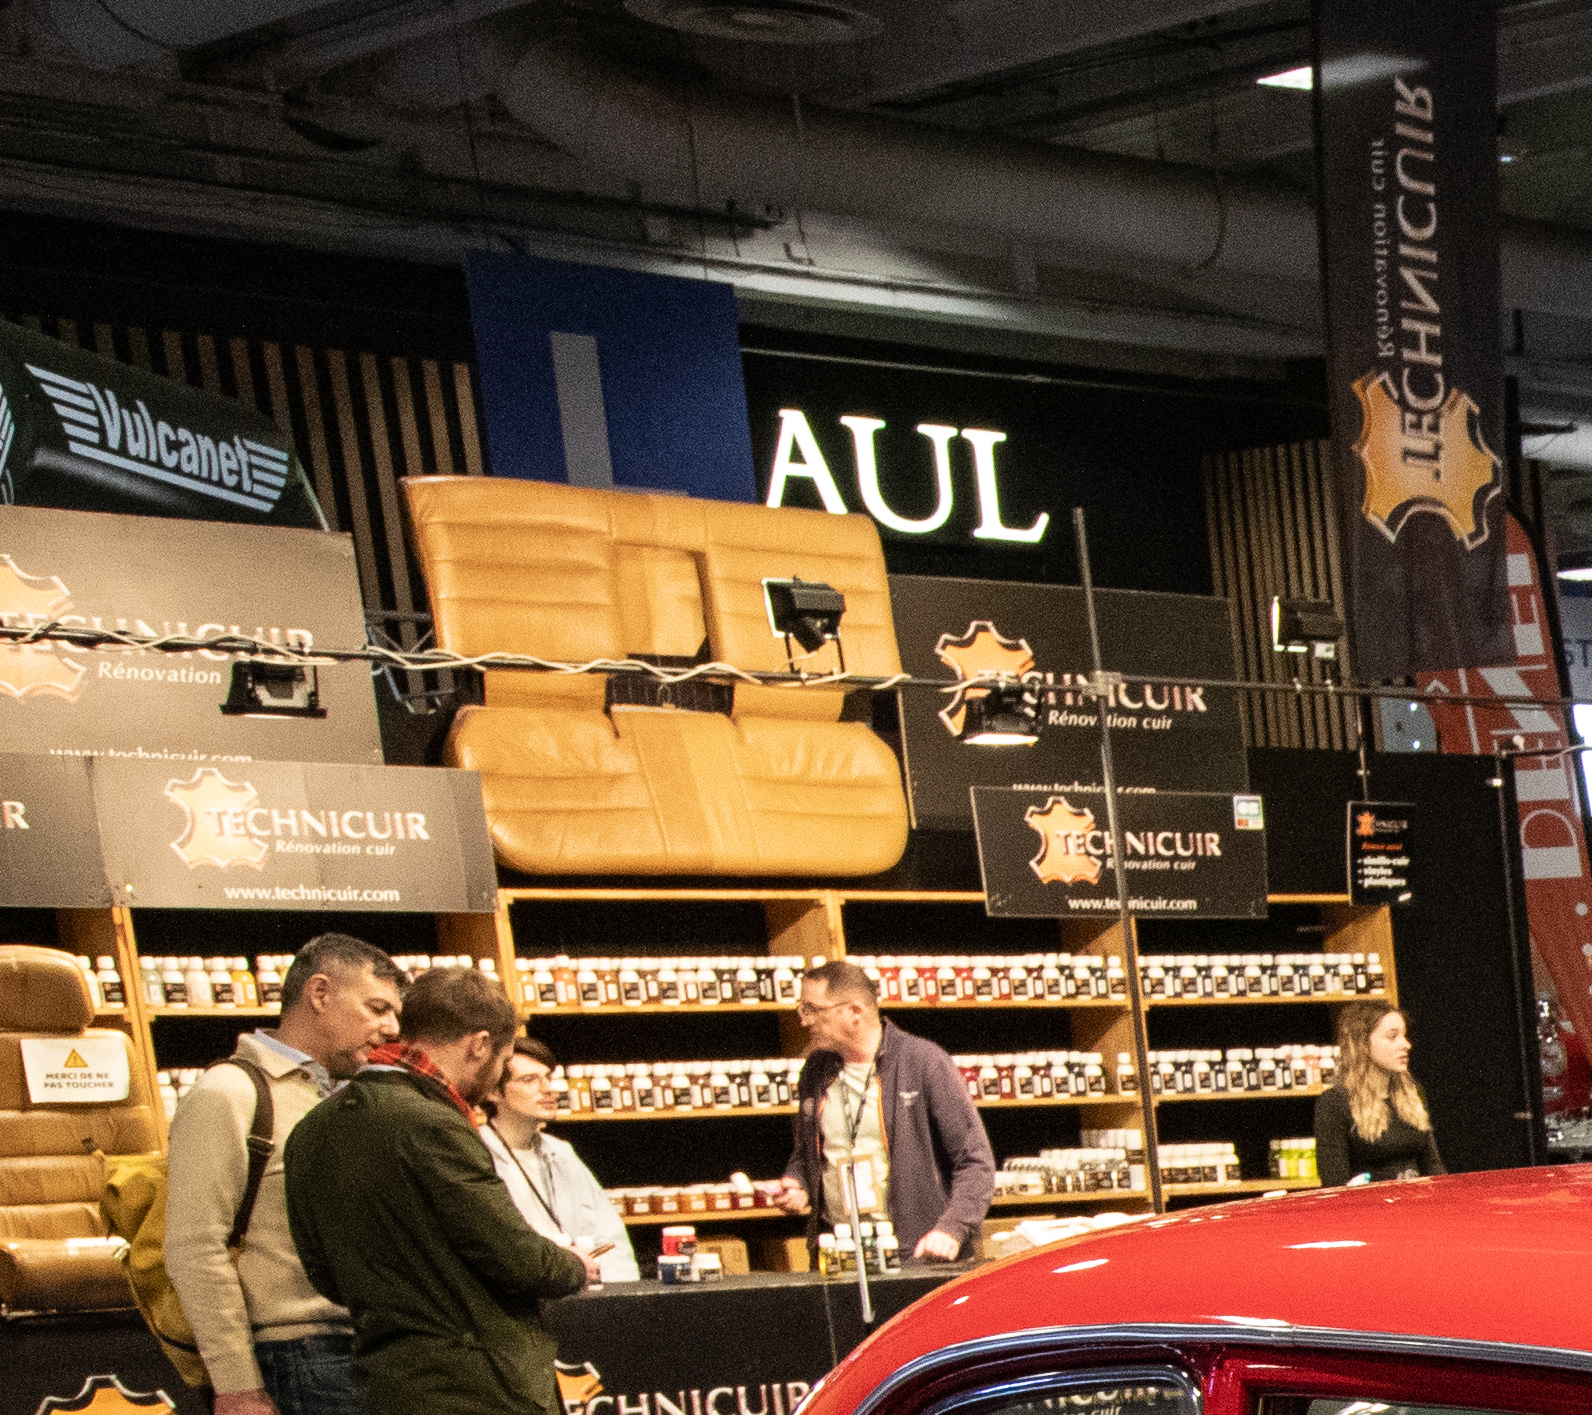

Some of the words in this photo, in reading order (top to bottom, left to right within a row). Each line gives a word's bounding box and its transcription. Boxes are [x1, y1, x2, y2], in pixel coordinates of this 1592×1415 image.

[86, 382, 252, 493] Vulcanet
[98, 661, 223, 686] Rénovation
[1048, 710, 1138, 729] Rénovtion
[1143, 715, 1173, 731] cuir
[204, 806, 430, 841] TECHNICUIR
[275, 839, 361, 856] Rénovation
[365, 842, 397, 857] cuir
[1106, 858, 1171, 871] Rnovation
[224, 883, 401, 903] www.technicuir.com
[43, 1081, 63, 1089] PAS
[66, 1081, 115, 1089] TOUCHER
[45, 1072, 78, 1080] MERCI
[80, 1072, 93, 1080] DE
[96, 1072, 110, 1080] NE
